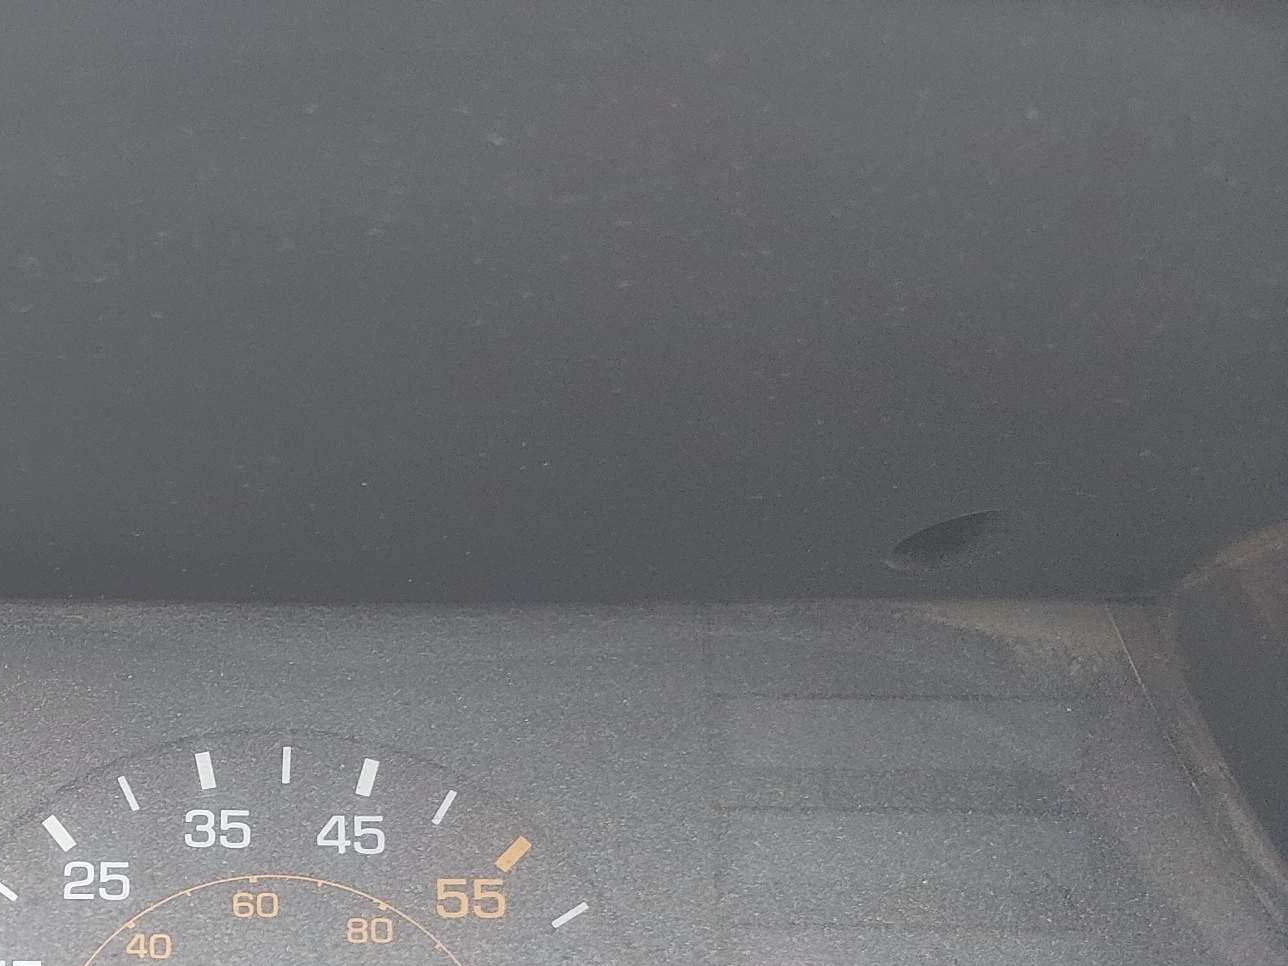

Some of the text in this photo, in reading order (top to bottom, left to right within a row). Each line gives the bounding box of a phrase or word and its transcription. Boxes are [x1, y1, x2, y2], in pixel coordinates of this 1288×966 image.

[184, 809, 252, 849] 35
[316, 815, 387, 855] 45
[63, 861, 131, 902] 25
[436, 878, 506, 919] 55
[232, 891, 280, 919] 60
[126, 932, 173, 960] 40
[346, 917, 394, 944] 80
